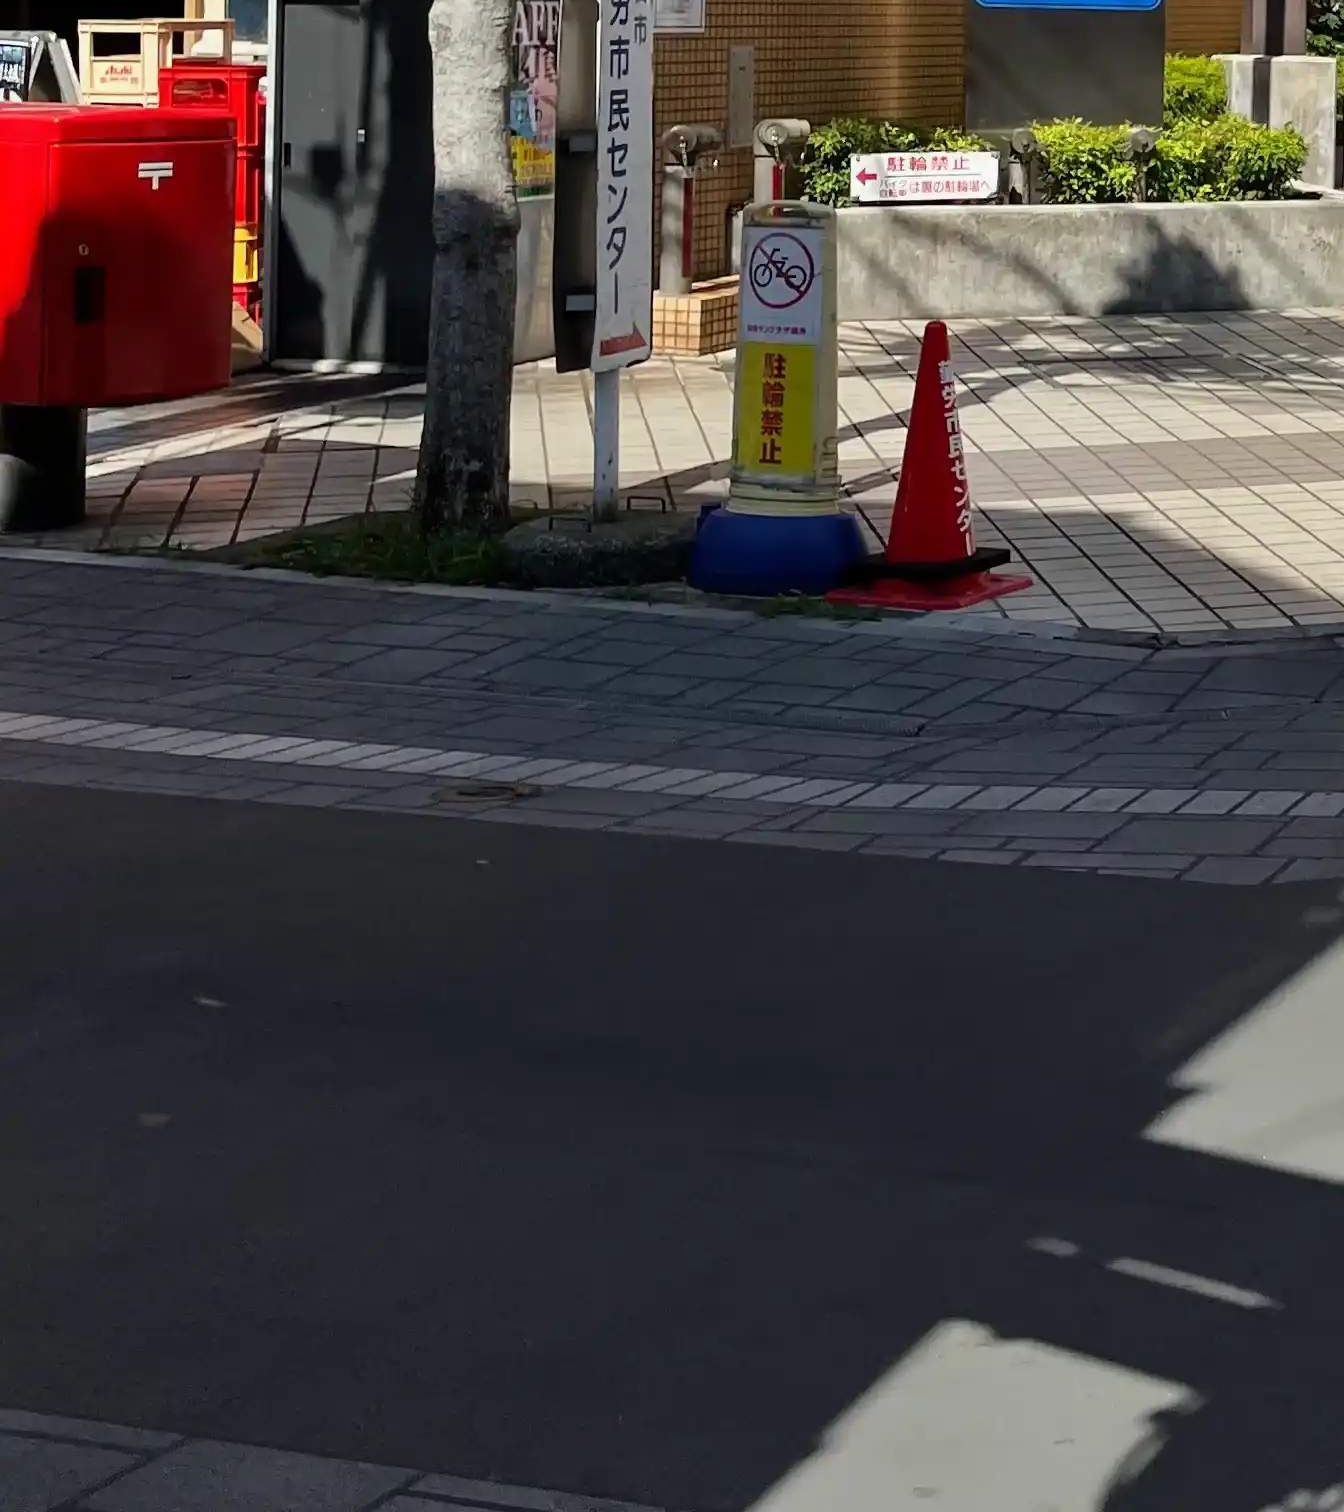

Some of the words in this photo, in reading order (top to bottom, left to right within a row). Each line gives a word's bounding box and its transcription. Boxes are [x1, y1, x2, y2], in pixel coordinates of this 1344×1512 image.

[886, 156, 970, 172] 駐輪禁止
[758, 352, 787, 465] 駐輪禁止
